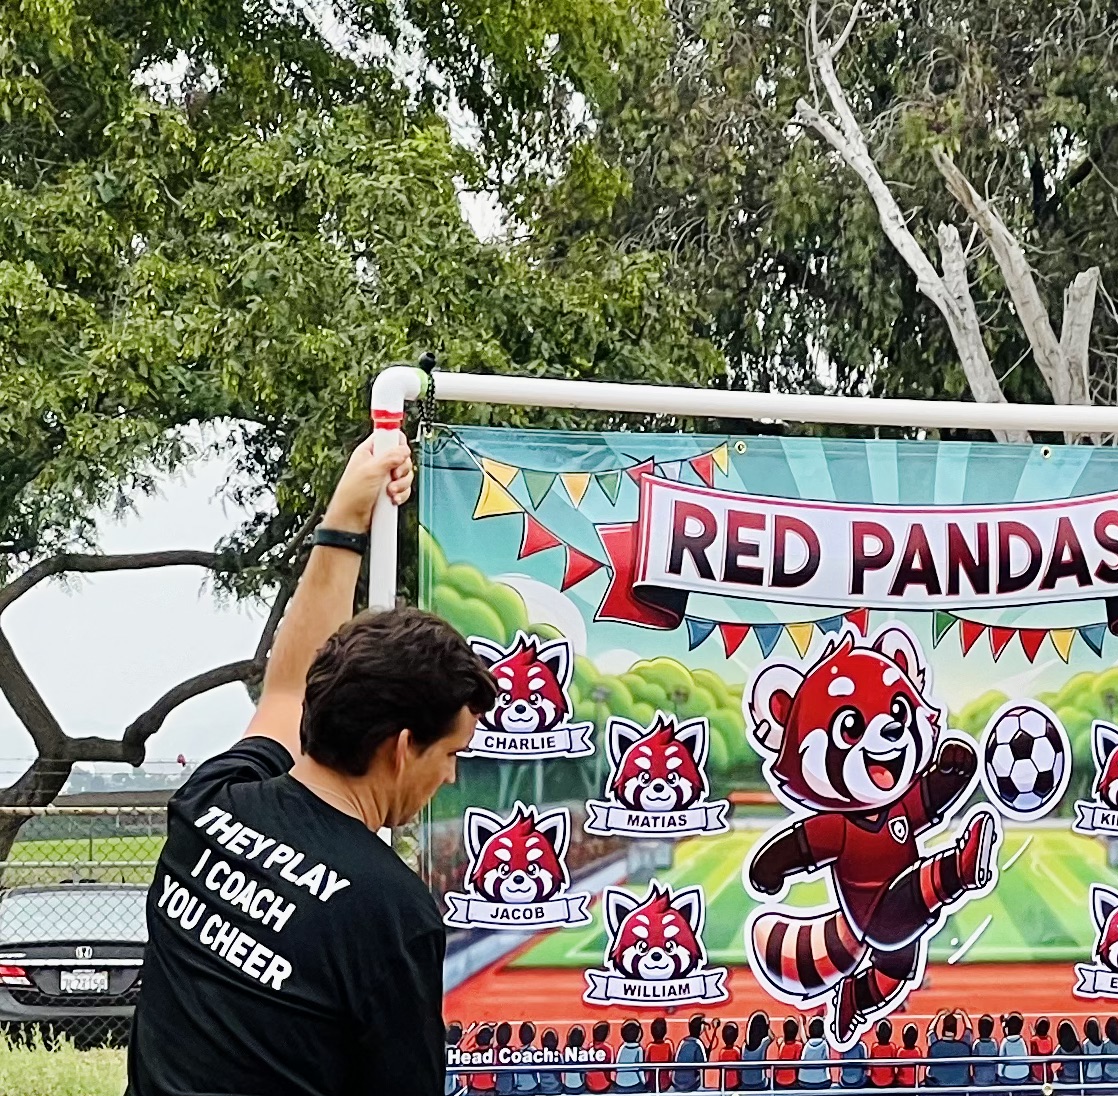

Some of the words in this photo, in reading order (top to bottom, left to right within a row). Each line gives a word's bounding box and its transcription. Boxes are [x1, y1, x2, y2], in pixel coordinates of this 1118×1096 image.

[666, 500, 821, 588] RED
[483, 735, 557, 751] CHARLIE
[626, 813, 688, 829] MATIAS
[194, 805, 276, 860] THEY
[262, 843, 351, 902] PLAY
[190, 848, 212, 878] I
[205, 860, 297, 933] COACH
[489, 904, 546, 921] JACOB
[157, 874, 207, 931] YOU
[199, 913, 293, 991] CHEER
[622, 981, 691, 998] WILLIAM
[447, 1047, 493, 1065] Head
[498, 1047, 560, 1064] Coach:
[564, 1046, 607, 1062] Nate
